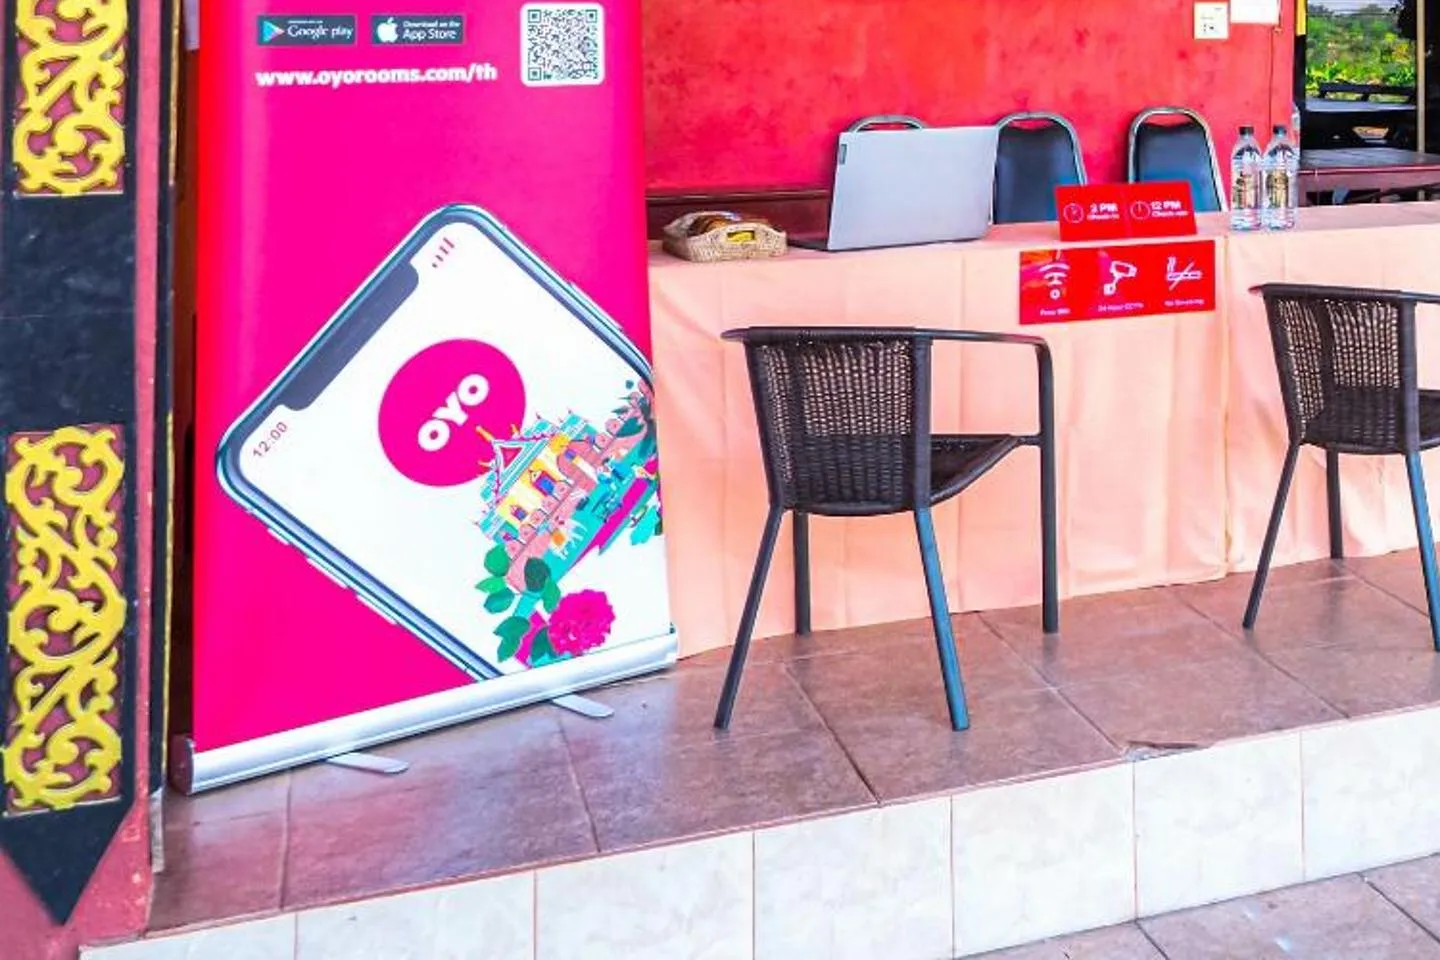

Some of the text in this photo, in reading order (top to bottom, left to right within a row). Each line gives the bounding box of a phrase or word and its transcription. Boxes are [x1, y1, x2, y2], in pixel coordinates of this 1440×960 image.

[287, 24, 354, 40] Google play
[402, 28, 457, 41] App Store
[255, 63, 498, 88] www.oyorooms.com/th
[417, 373, 490, 452] OYO
[252, 421, 289, 459] 12:00
